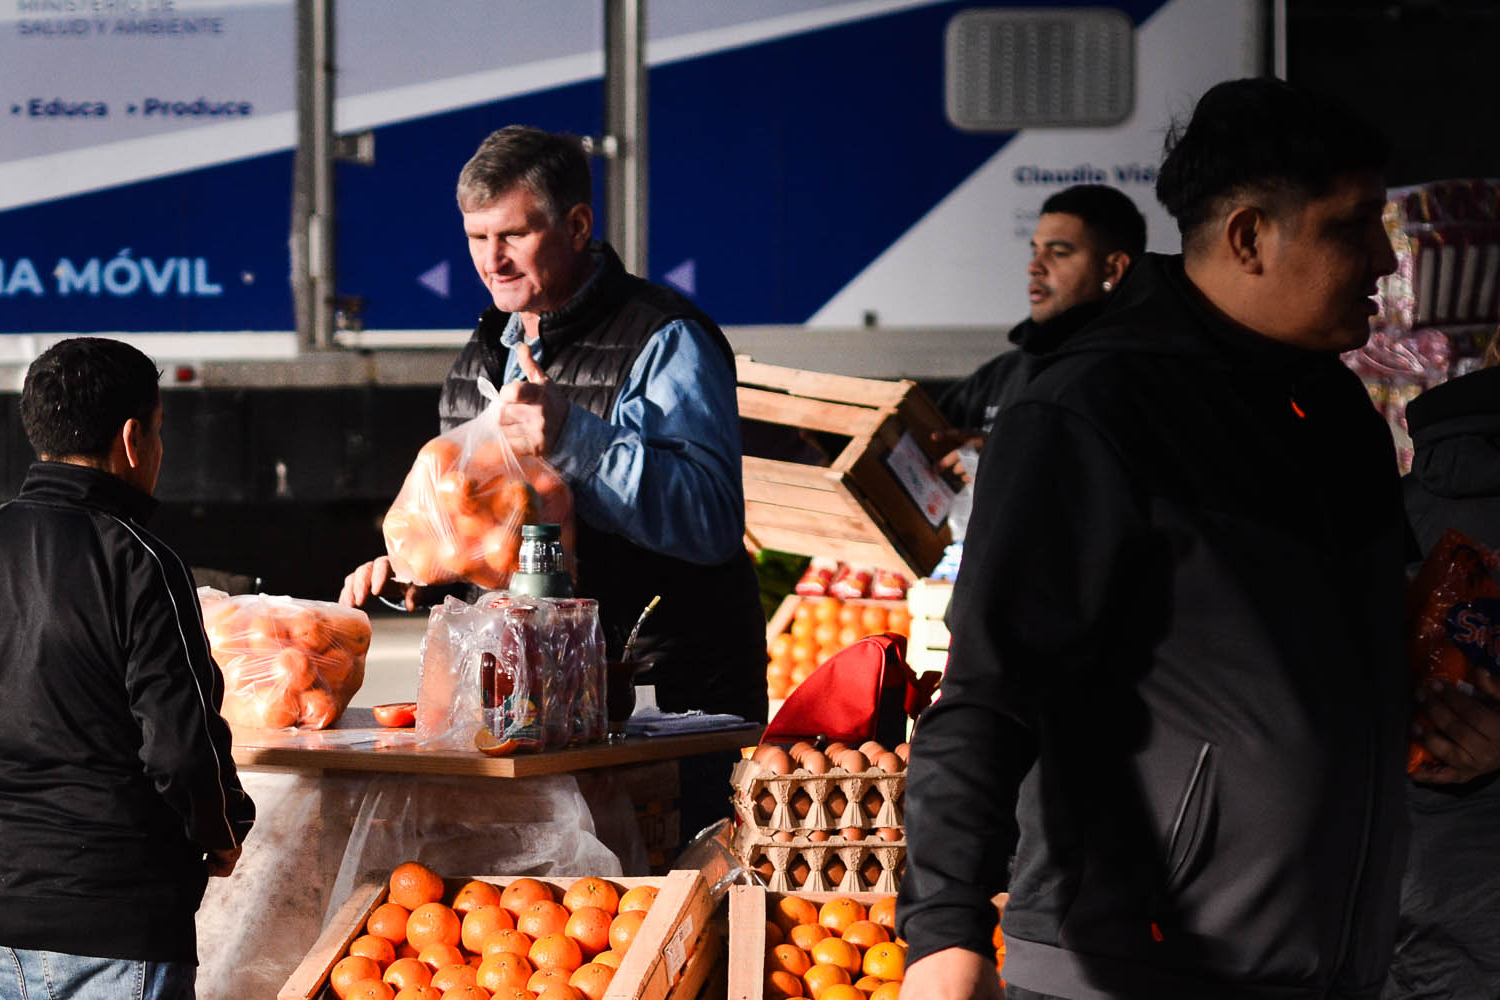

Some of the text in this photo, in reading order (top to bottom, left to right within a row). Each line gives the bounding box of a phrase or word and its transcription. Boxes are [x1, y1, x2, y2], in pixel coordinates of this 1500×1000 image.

[111, 18, 225, 34] AMBIENTE
[28, 98, 108, 116] Educa
[144, 98, 253, 116] Produce
[56, 248, 223, 295] MÓVIL
